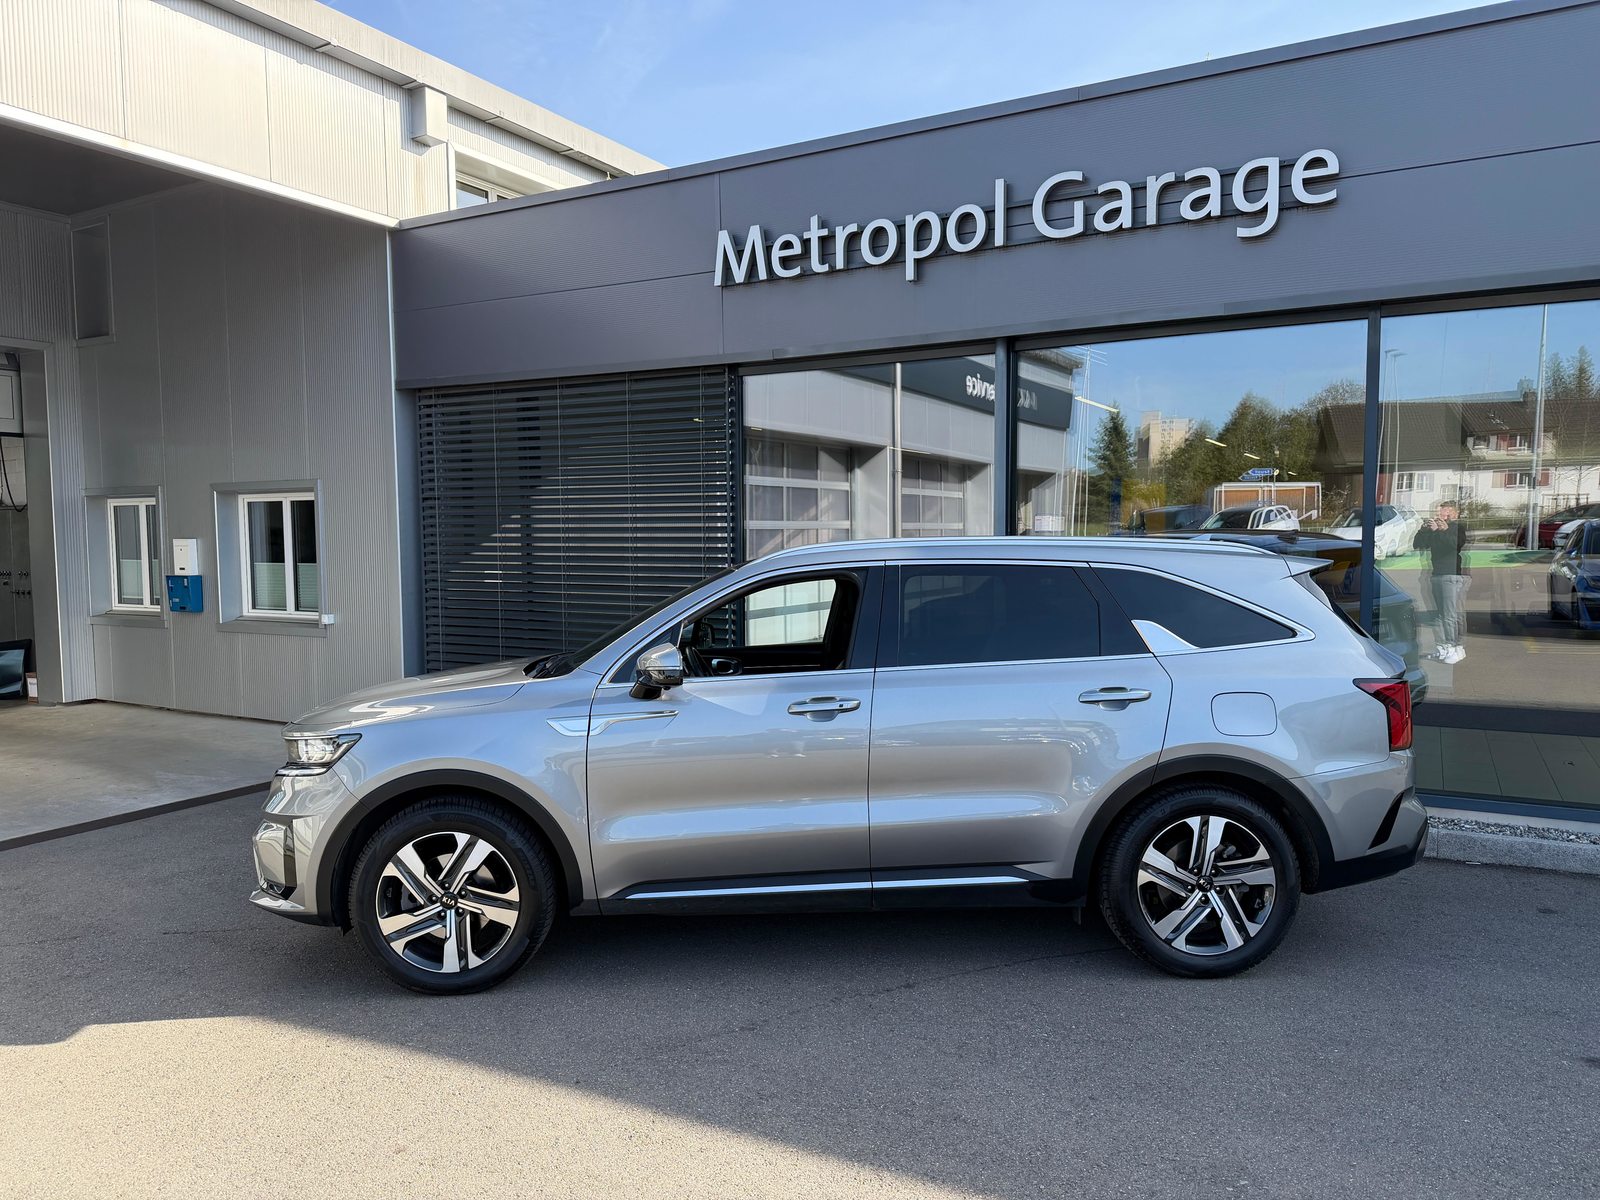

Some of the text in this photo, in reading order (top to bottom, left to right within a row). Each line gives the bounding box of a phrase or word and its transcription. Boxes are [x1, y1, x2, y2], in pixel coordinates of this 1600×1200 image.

[714, 148, 1340, 287] Metropol Garage
[442, 896, 455, 906] KIA
